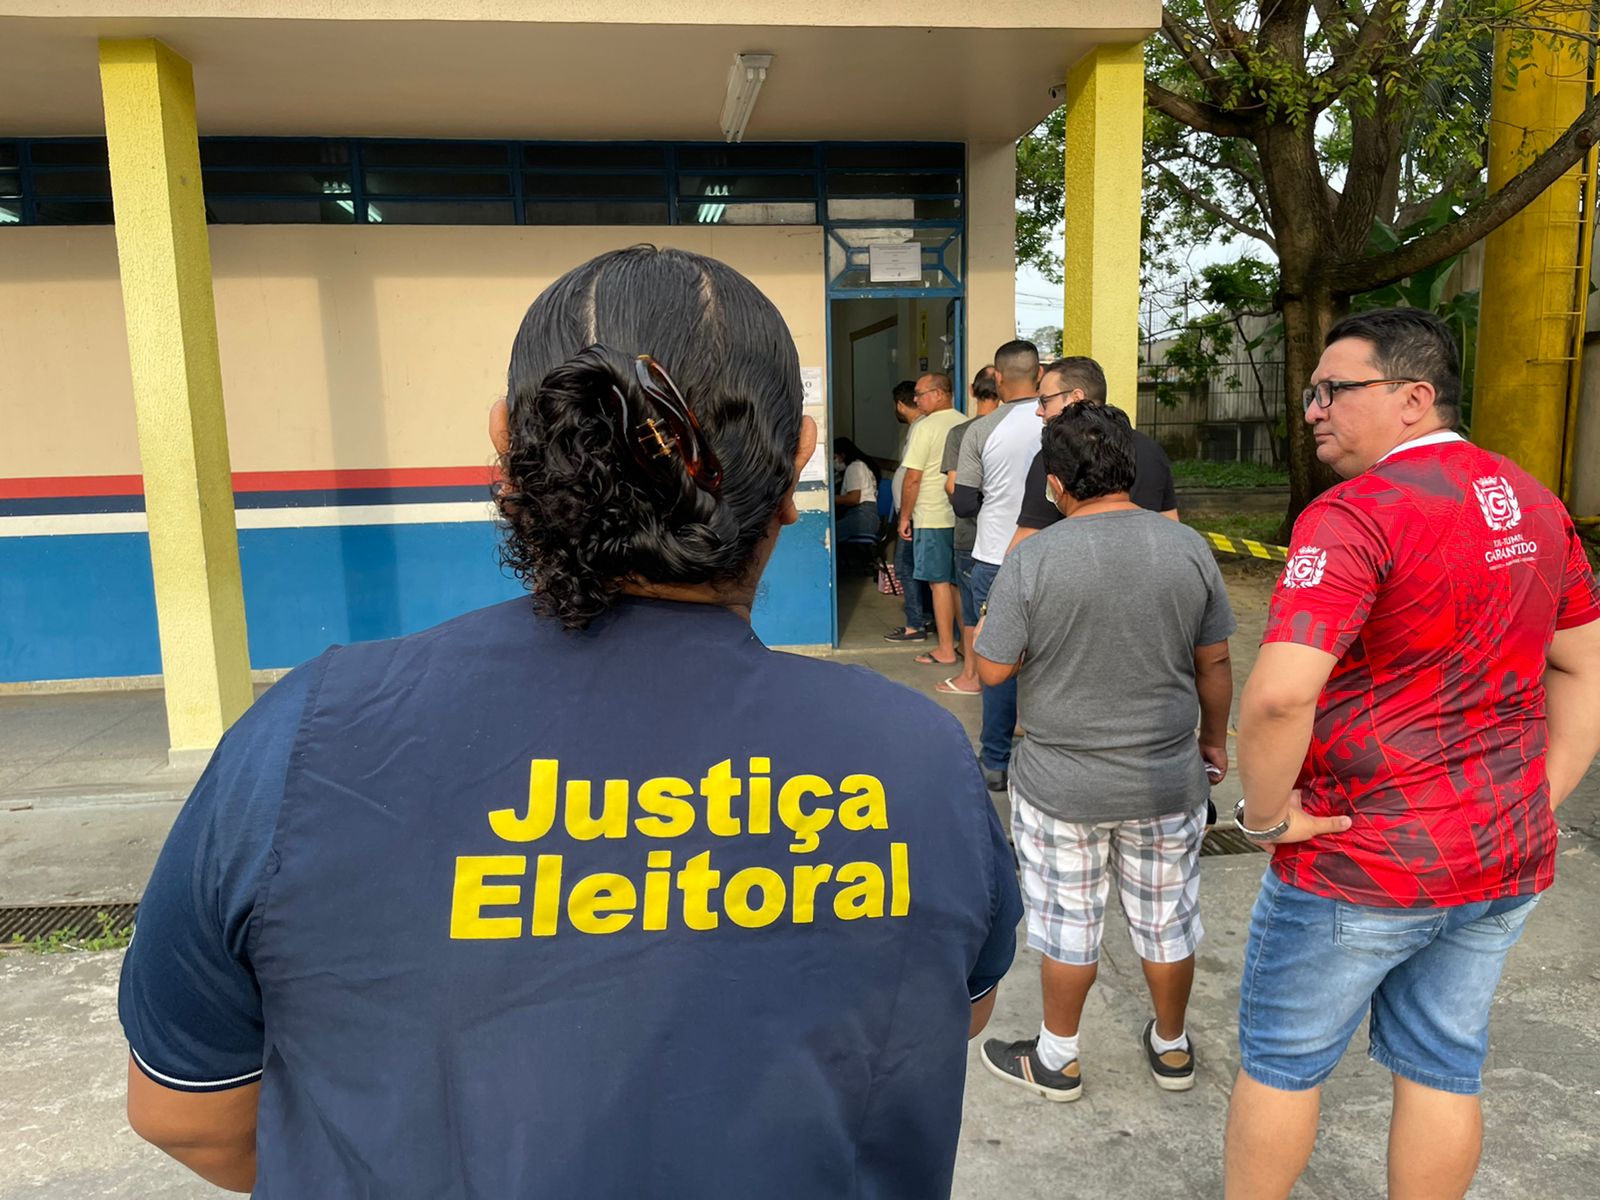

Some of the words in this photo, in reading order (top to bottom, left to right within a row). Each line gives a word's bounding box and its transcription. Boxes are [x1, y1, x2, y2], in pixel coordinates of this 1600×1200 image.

[1488, 491, 1506, 516] G
[1295, 558, 1312, 579] G
[488, 757, 889, 854] Justiça
[449, 842, 911, 940] Eleitoral
